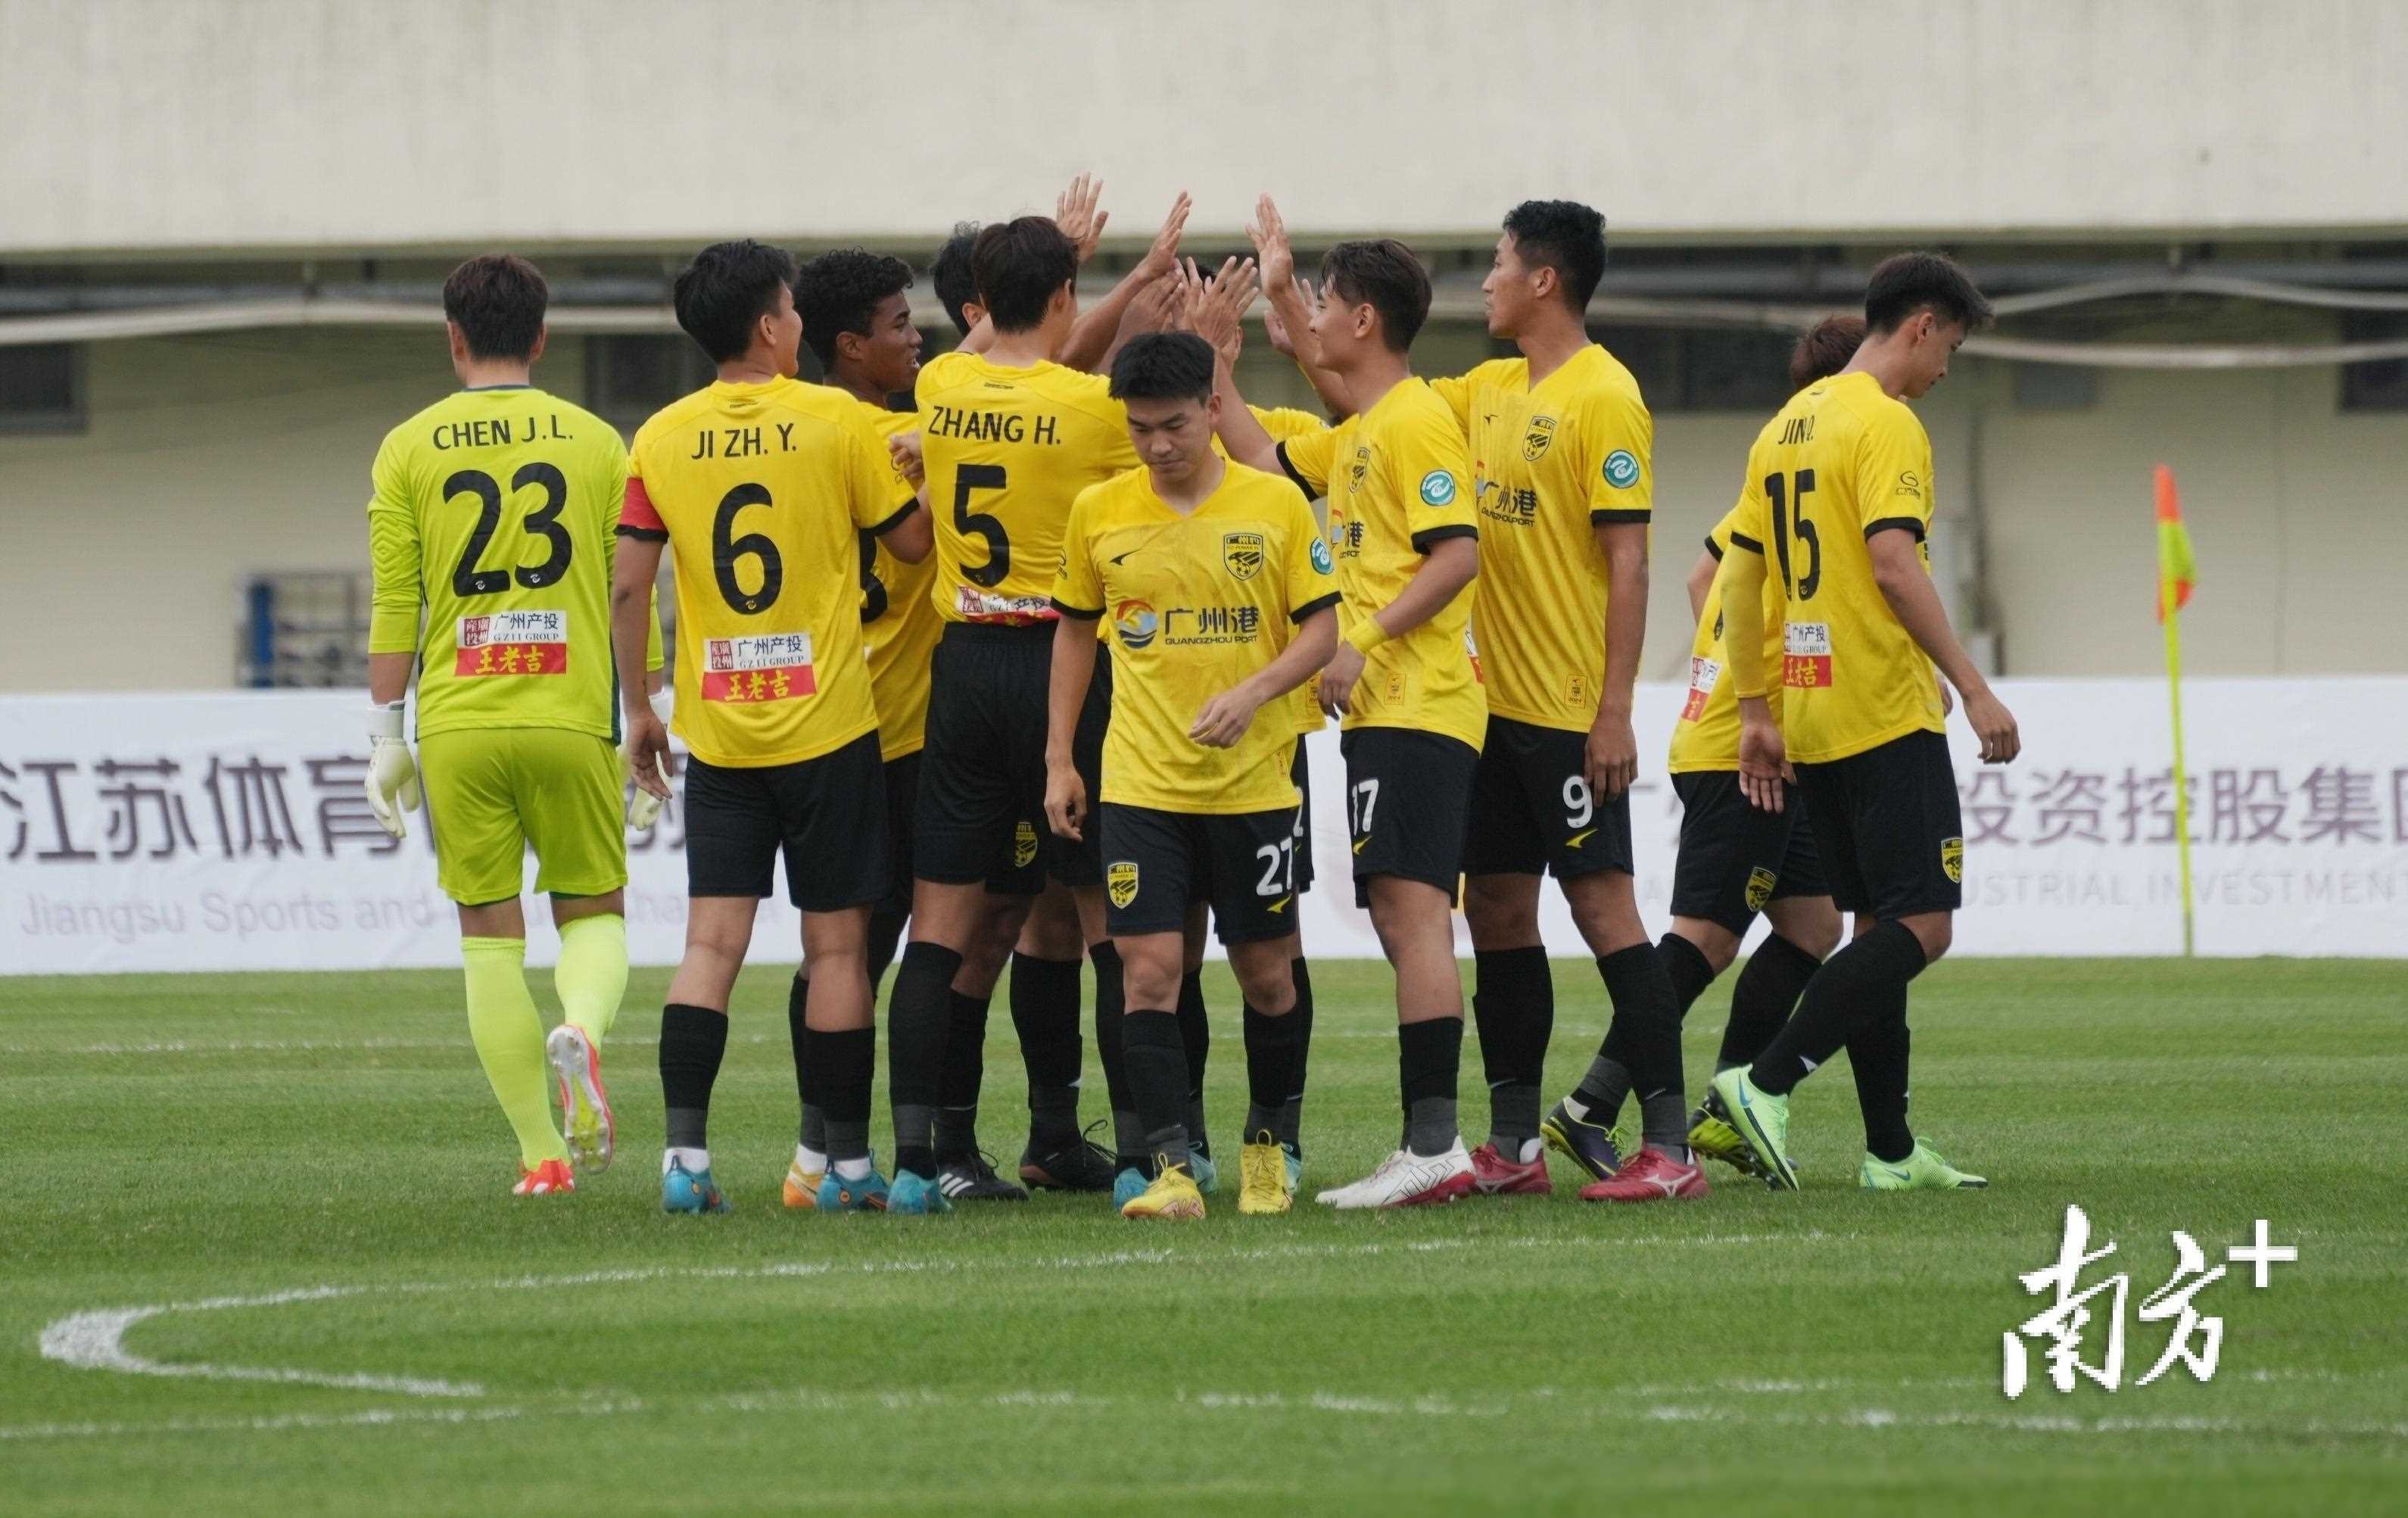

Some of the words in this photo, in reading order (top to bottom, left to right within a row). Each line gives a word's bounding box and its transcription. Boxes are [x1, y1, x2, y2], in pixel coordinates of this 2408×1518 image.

[432, 418, 512, 450] CHEN
[521, 415, 574, 443] J.L.
[691, 430, 714, 460] JI
[724, 426, 768, 457] ZH.
[776, 422, 797, 452] Y.
[928, 405, 1024, 444] ZHANG
[1033, 416, 1061, 445] H.
[1777, 418, 1807, 445] JIN
[443, 462, 573, 597] 23
[954, 463, 1011, 588] 5
[1765, 468, 1821, 602] 15
[712, 482, 783, 616] 6
[494, 612, 559, 630] 广州产投
[525, 632, 559, 641] GROUP
[1165, 606, 1259, 634] 广州港
[738, 635, 802, 656] 广州产投
[1166, 637, 1232, 645] GUANGZHOU
[1235, 635, 1257, 644] PORT
[475, 645, 544, 675] 王老吉
[769, 656, 804, 667] GROUP
[724, 669, 791, 702] 王老吉
[1351, 778, 1379, 837] 17
[1562, 775, 1593, 829] 9
[1959, 763, 2408, 848] 投资控股集
[1257, 836, 1292, 896] 27
[20, 893, 185, 944] Jiangsu
[199, 891, 341, 942] Sports
